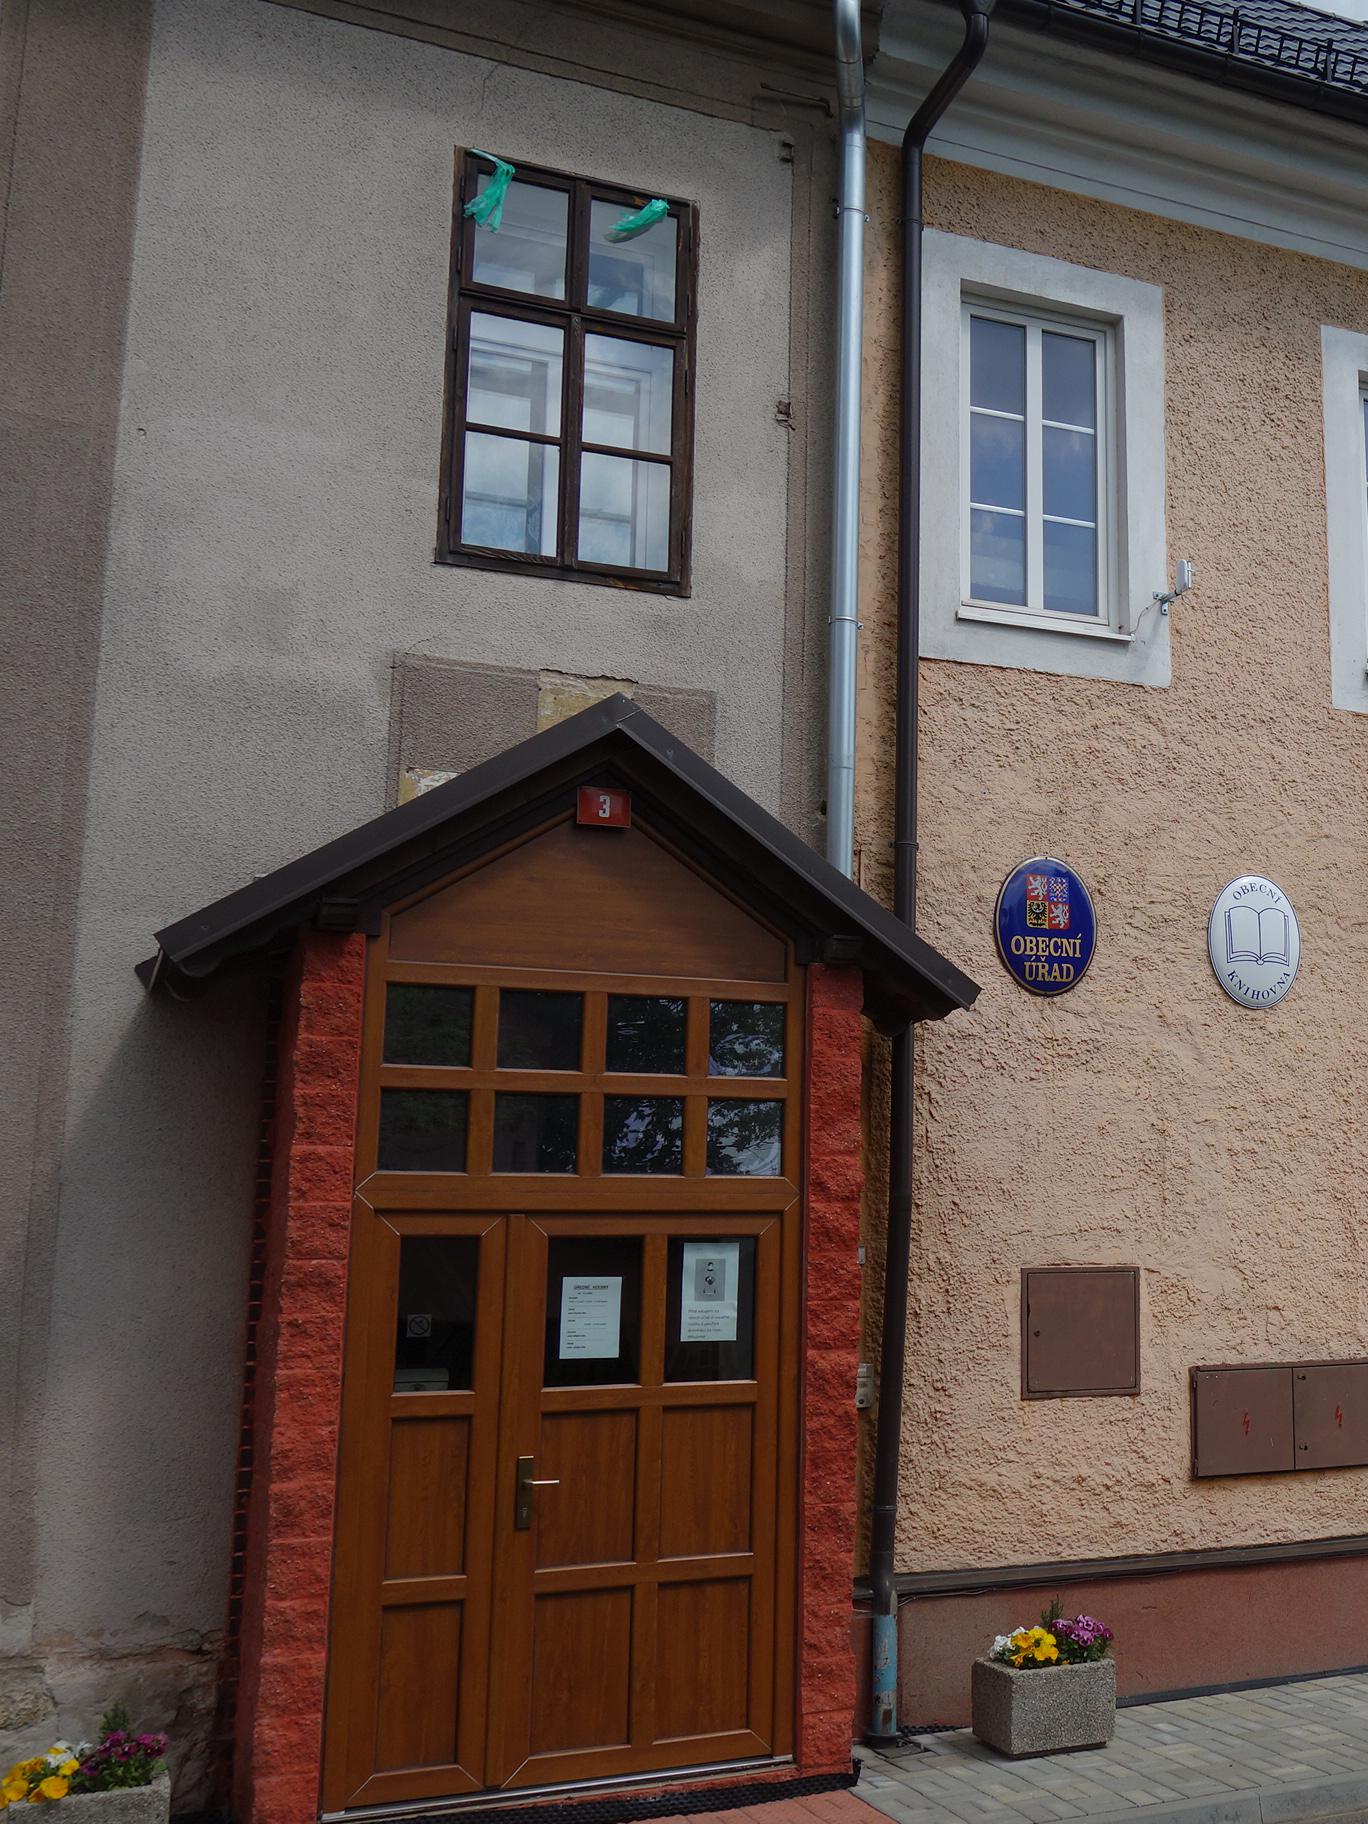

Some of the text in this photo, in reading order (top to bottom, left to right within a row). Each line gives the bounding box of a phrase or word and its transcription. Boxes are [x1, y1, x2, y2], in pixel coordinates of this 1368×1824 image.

[598, 795, 611, 818] 3
[1011, 933, 1081, 957] OBECNÍ
[1024, 956, 1074, 982] ÚŘAD
[1228, 970, 1290, 1000] KNIHOVNA
